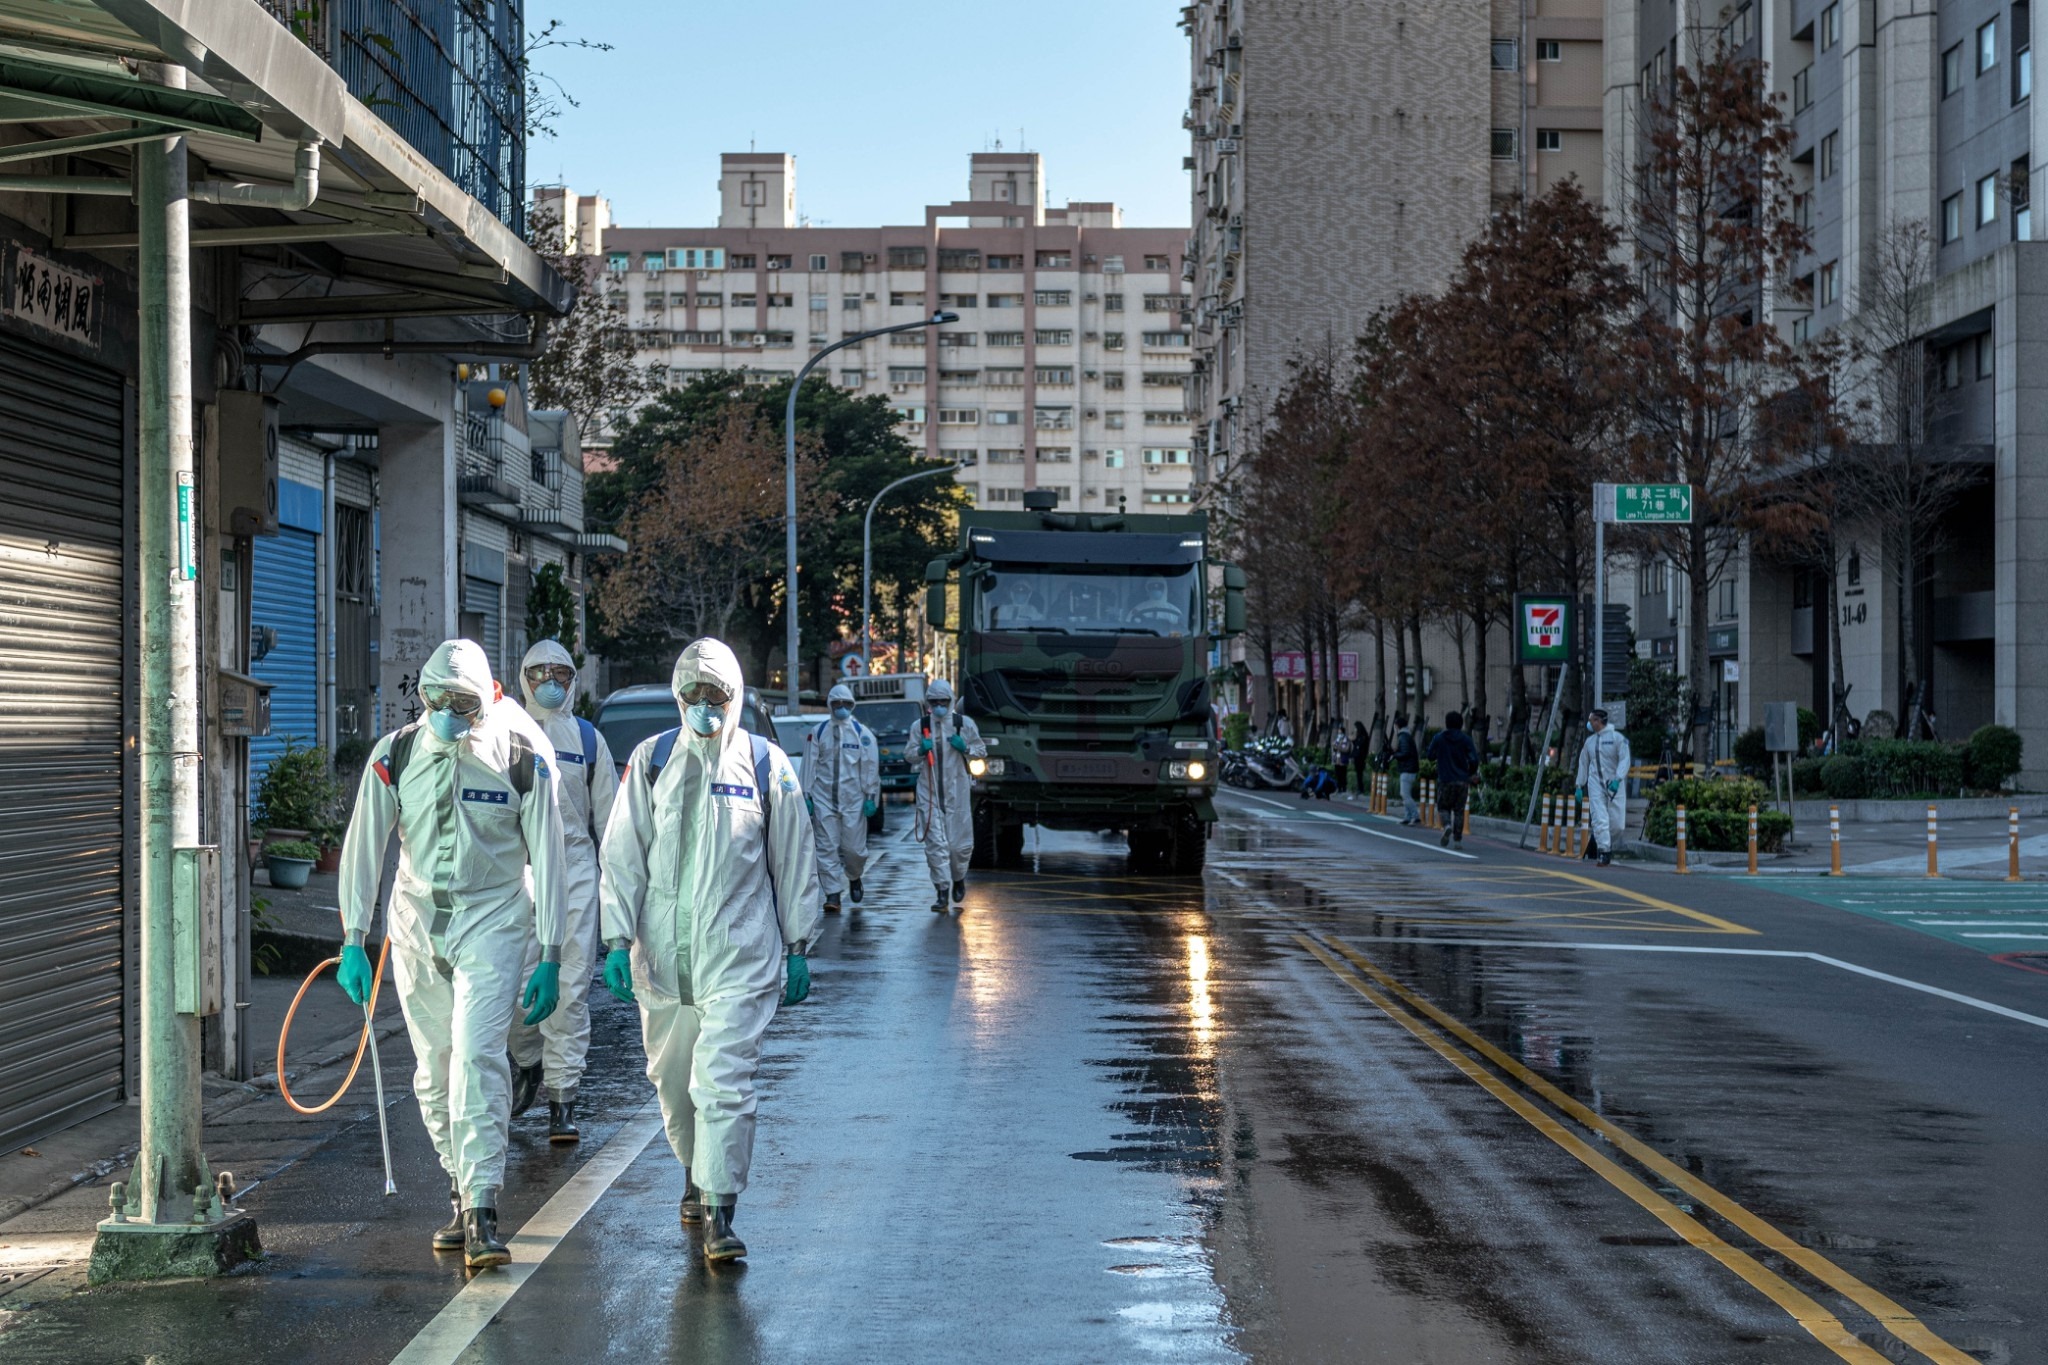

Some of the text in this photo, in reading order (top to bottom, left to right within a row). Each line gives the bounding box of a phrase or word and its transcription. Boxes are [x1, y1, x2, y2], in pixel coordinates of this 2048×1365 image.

[1626, 487, 1681, 500] 龍泉二街
[1531, 608, 1559, 646] 7
[1054, 660, 1122, 675] IVECO
